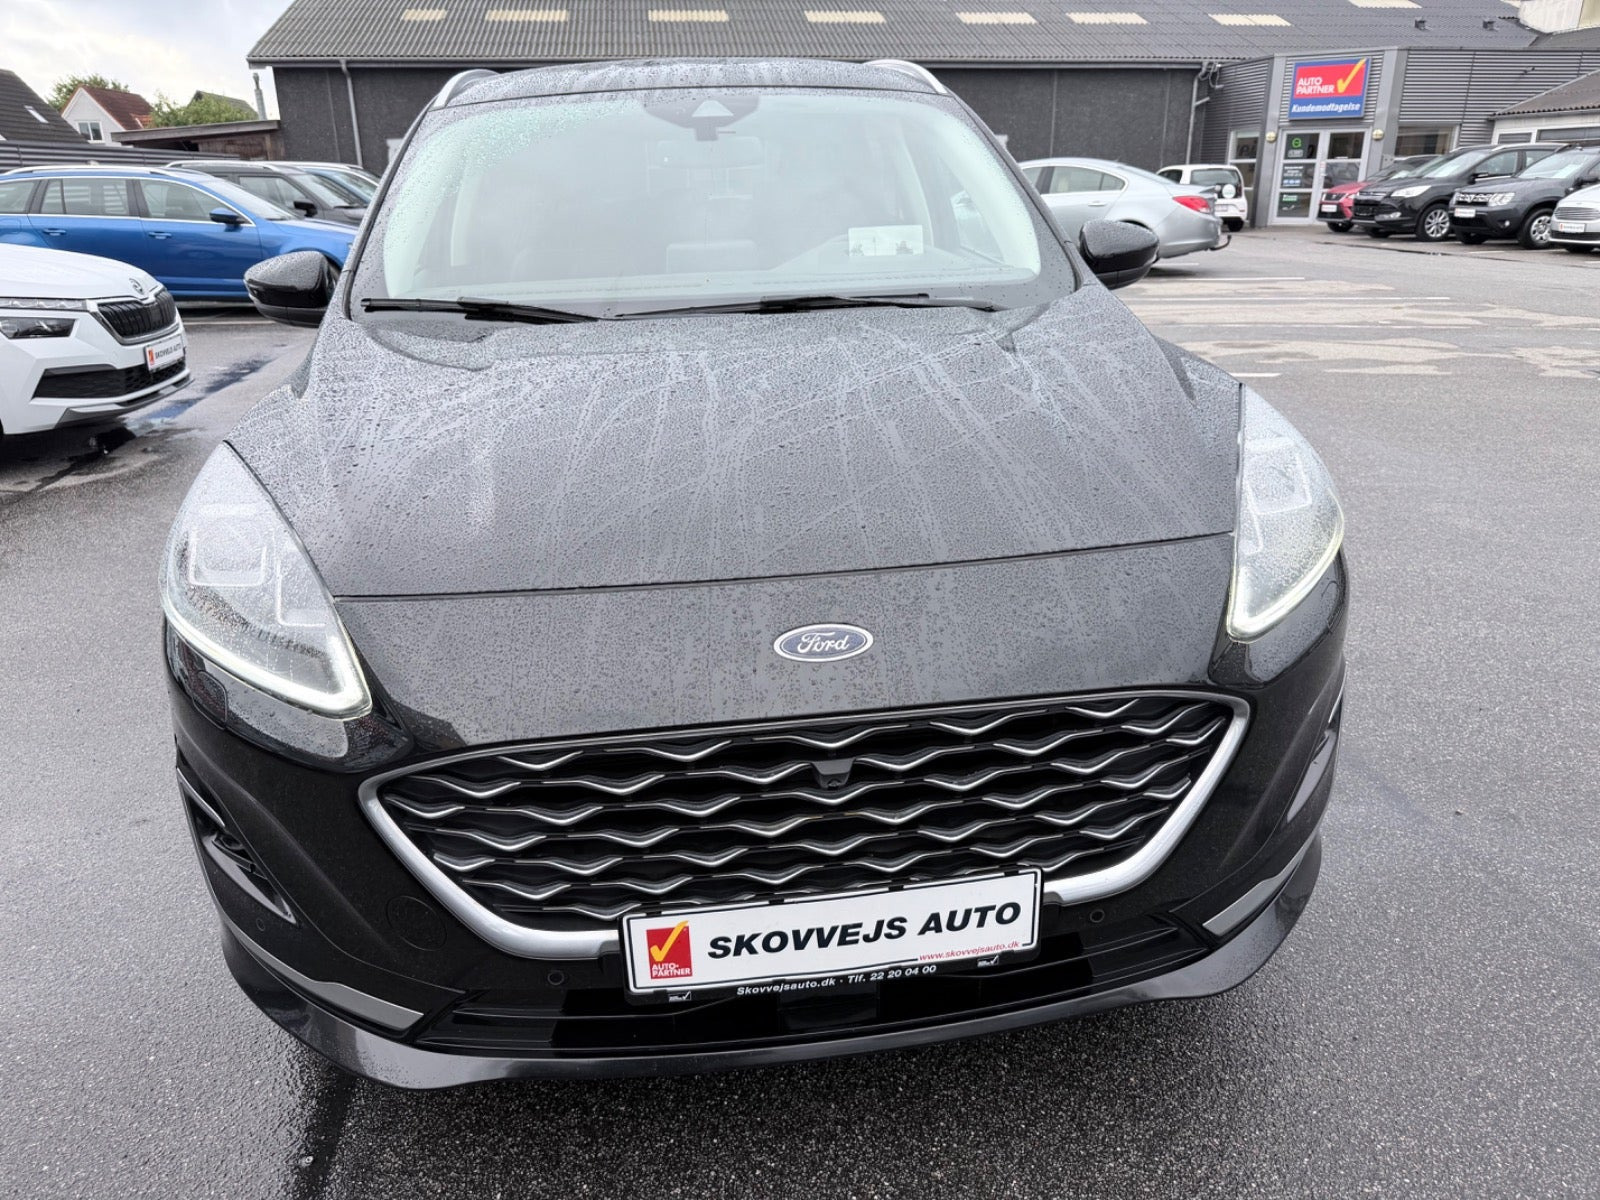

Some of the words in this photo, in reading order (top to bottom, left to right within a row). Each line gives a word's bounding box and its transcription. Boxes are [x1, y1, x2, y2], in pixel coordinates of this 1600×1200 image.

[1297, 77, 1323, 86] AUTO
[1295, 85, 1335, 95] PARTNER
[1291, 102, 1361, 113] Kundemodtagelse
[797, 631, 850, 654] Ford
[708, 916, 908, 959] SKOVVEJS
[917, 901, 1022, 936] AUTO
[919, 940, 1020, 962] www.skovvejsauto.dk
[651, 962, 679, 971] AUTO-
[652, 967, 691, 978] PARTNER
[736, 977, 836, 996] Skovvejsauto.dk
[869, 971, 885, 981] 22
[887, 969, 902, 979] 20
[904, 966, 920, 977] 04
[922, 964, 937, 974] 00
